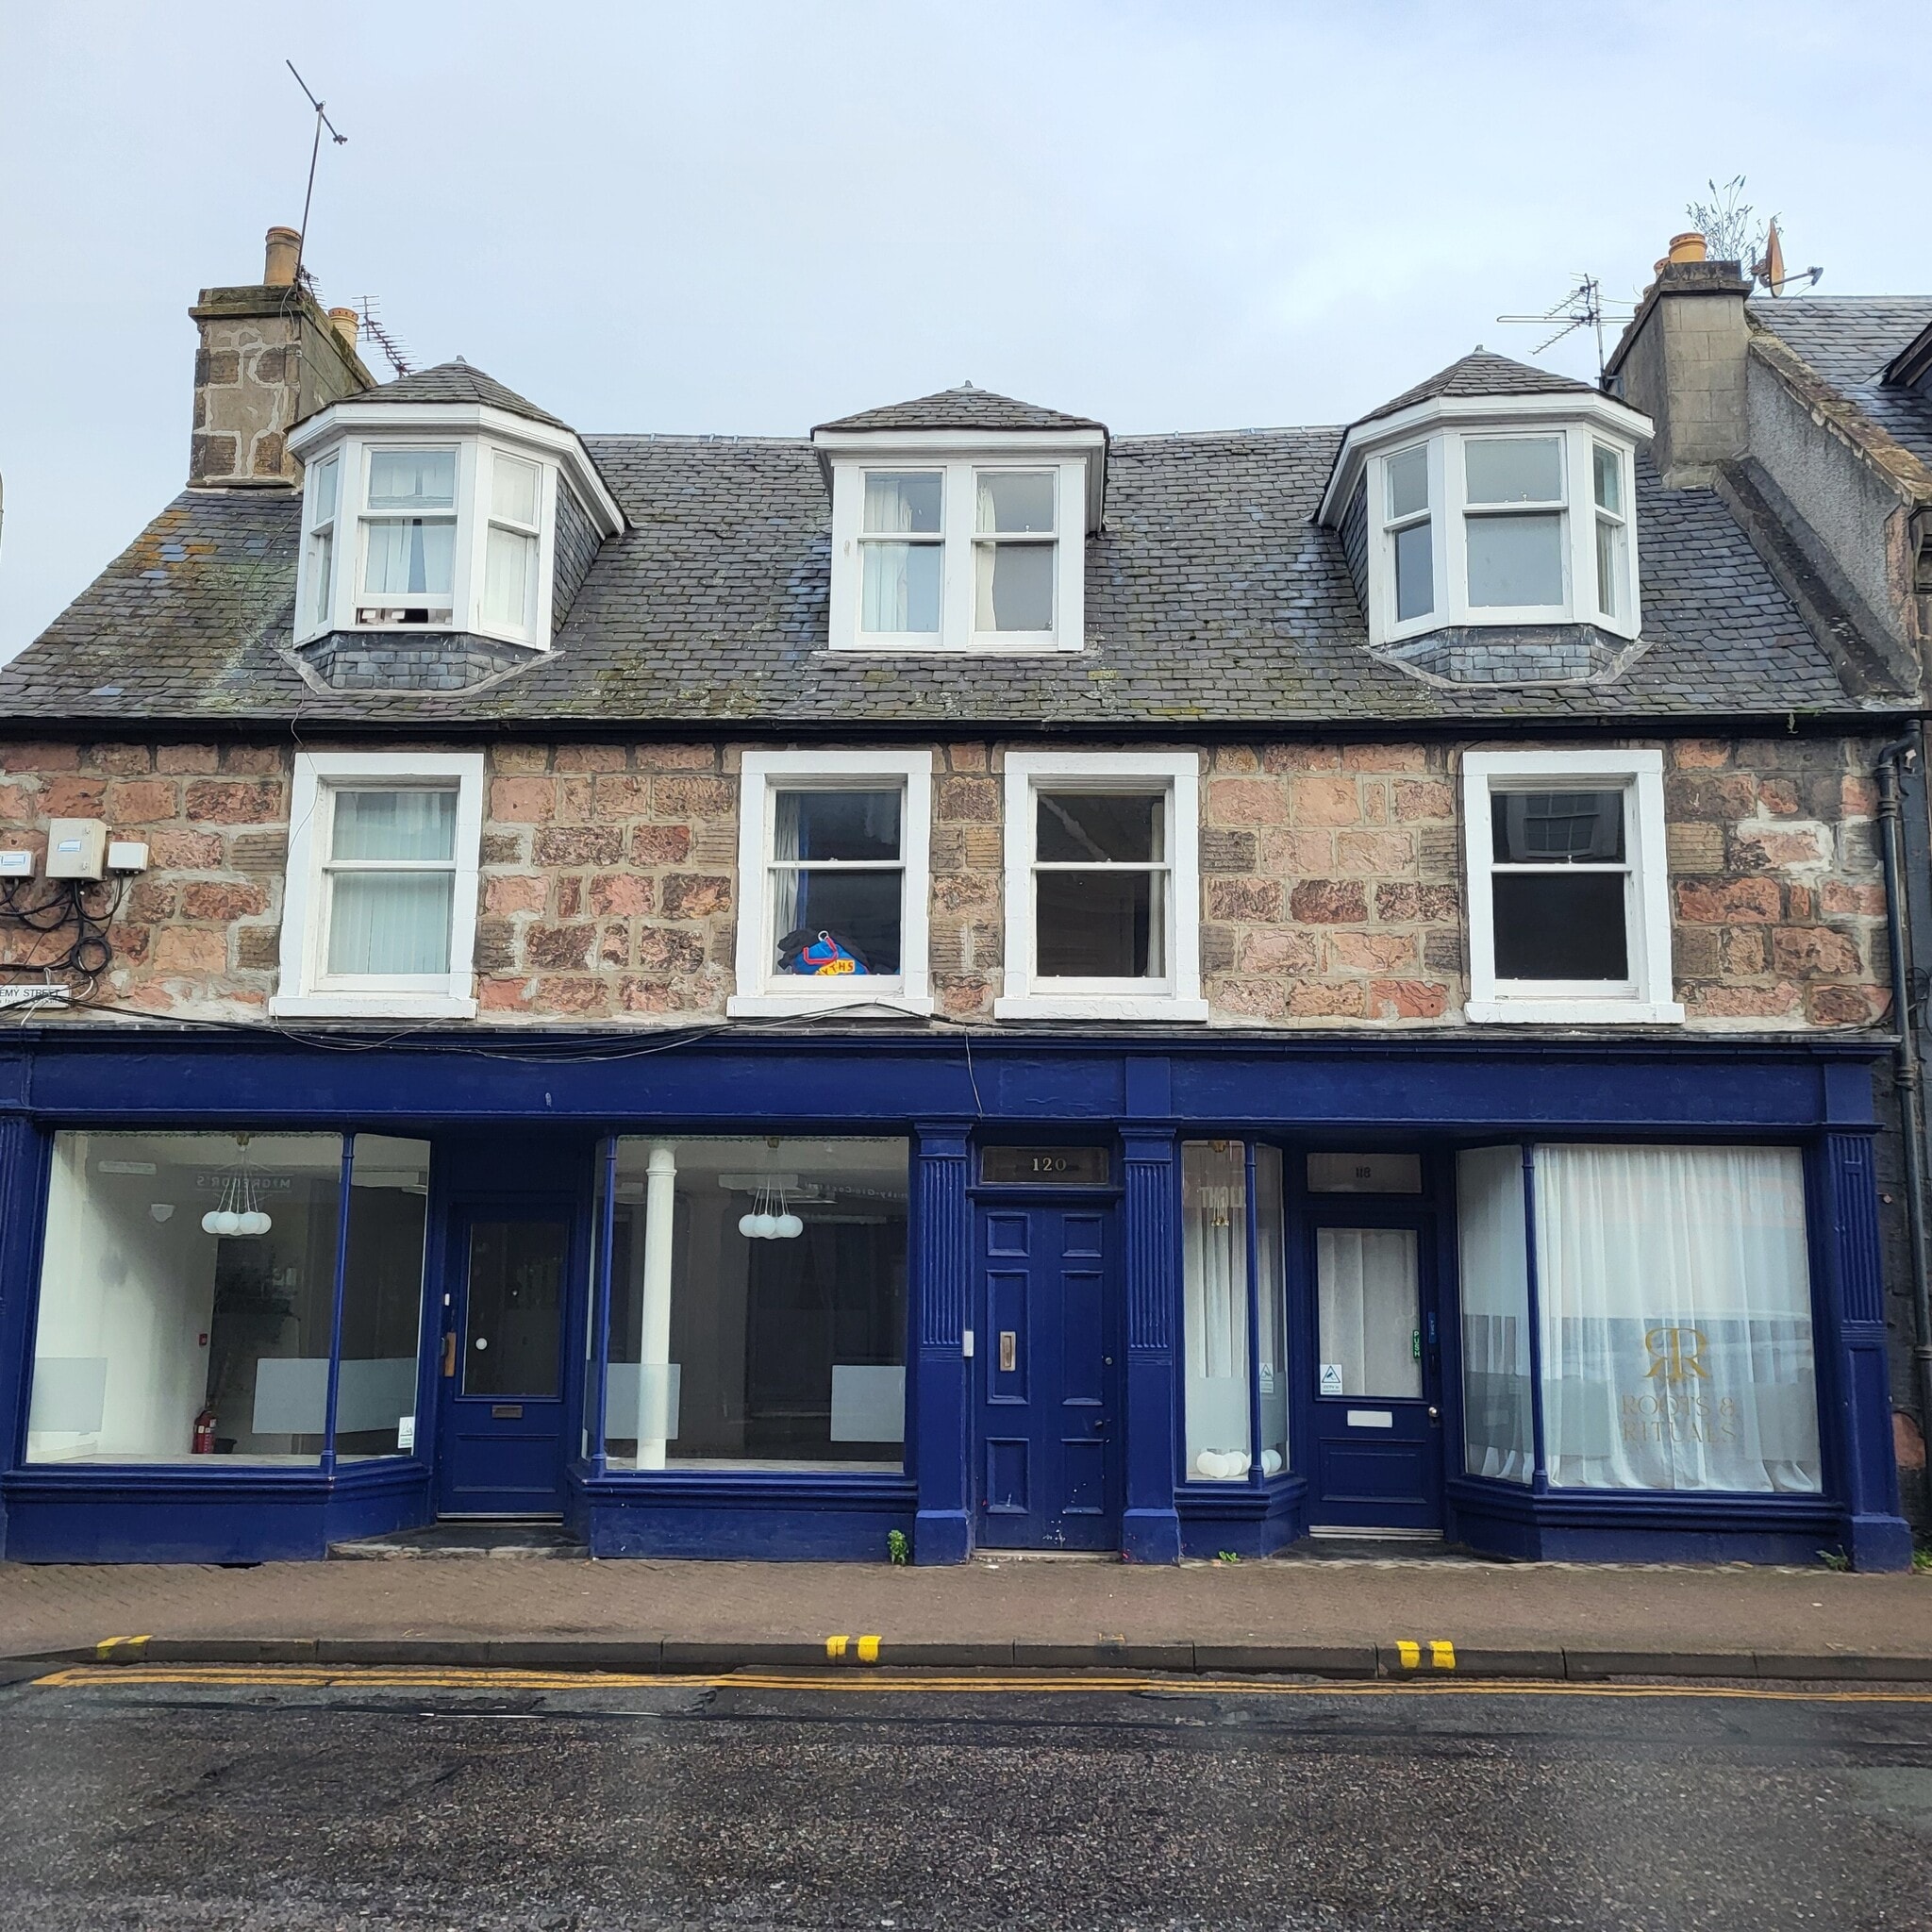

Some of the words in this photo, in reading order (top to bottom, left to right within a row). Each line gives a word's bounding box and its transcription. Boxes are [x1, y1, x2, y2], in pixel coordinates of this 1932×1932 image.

[818, 961, 854, 975] YTHS
[1033, 1158, 1067, 1172] 120
[1356, 1167, 1372, 1178] 118
[1623, 1395, 1710, 1416] ROOTS
[1720, 1396, 1735, 1416] &
[1623, 1421, 1737, 1442] RITUALS
